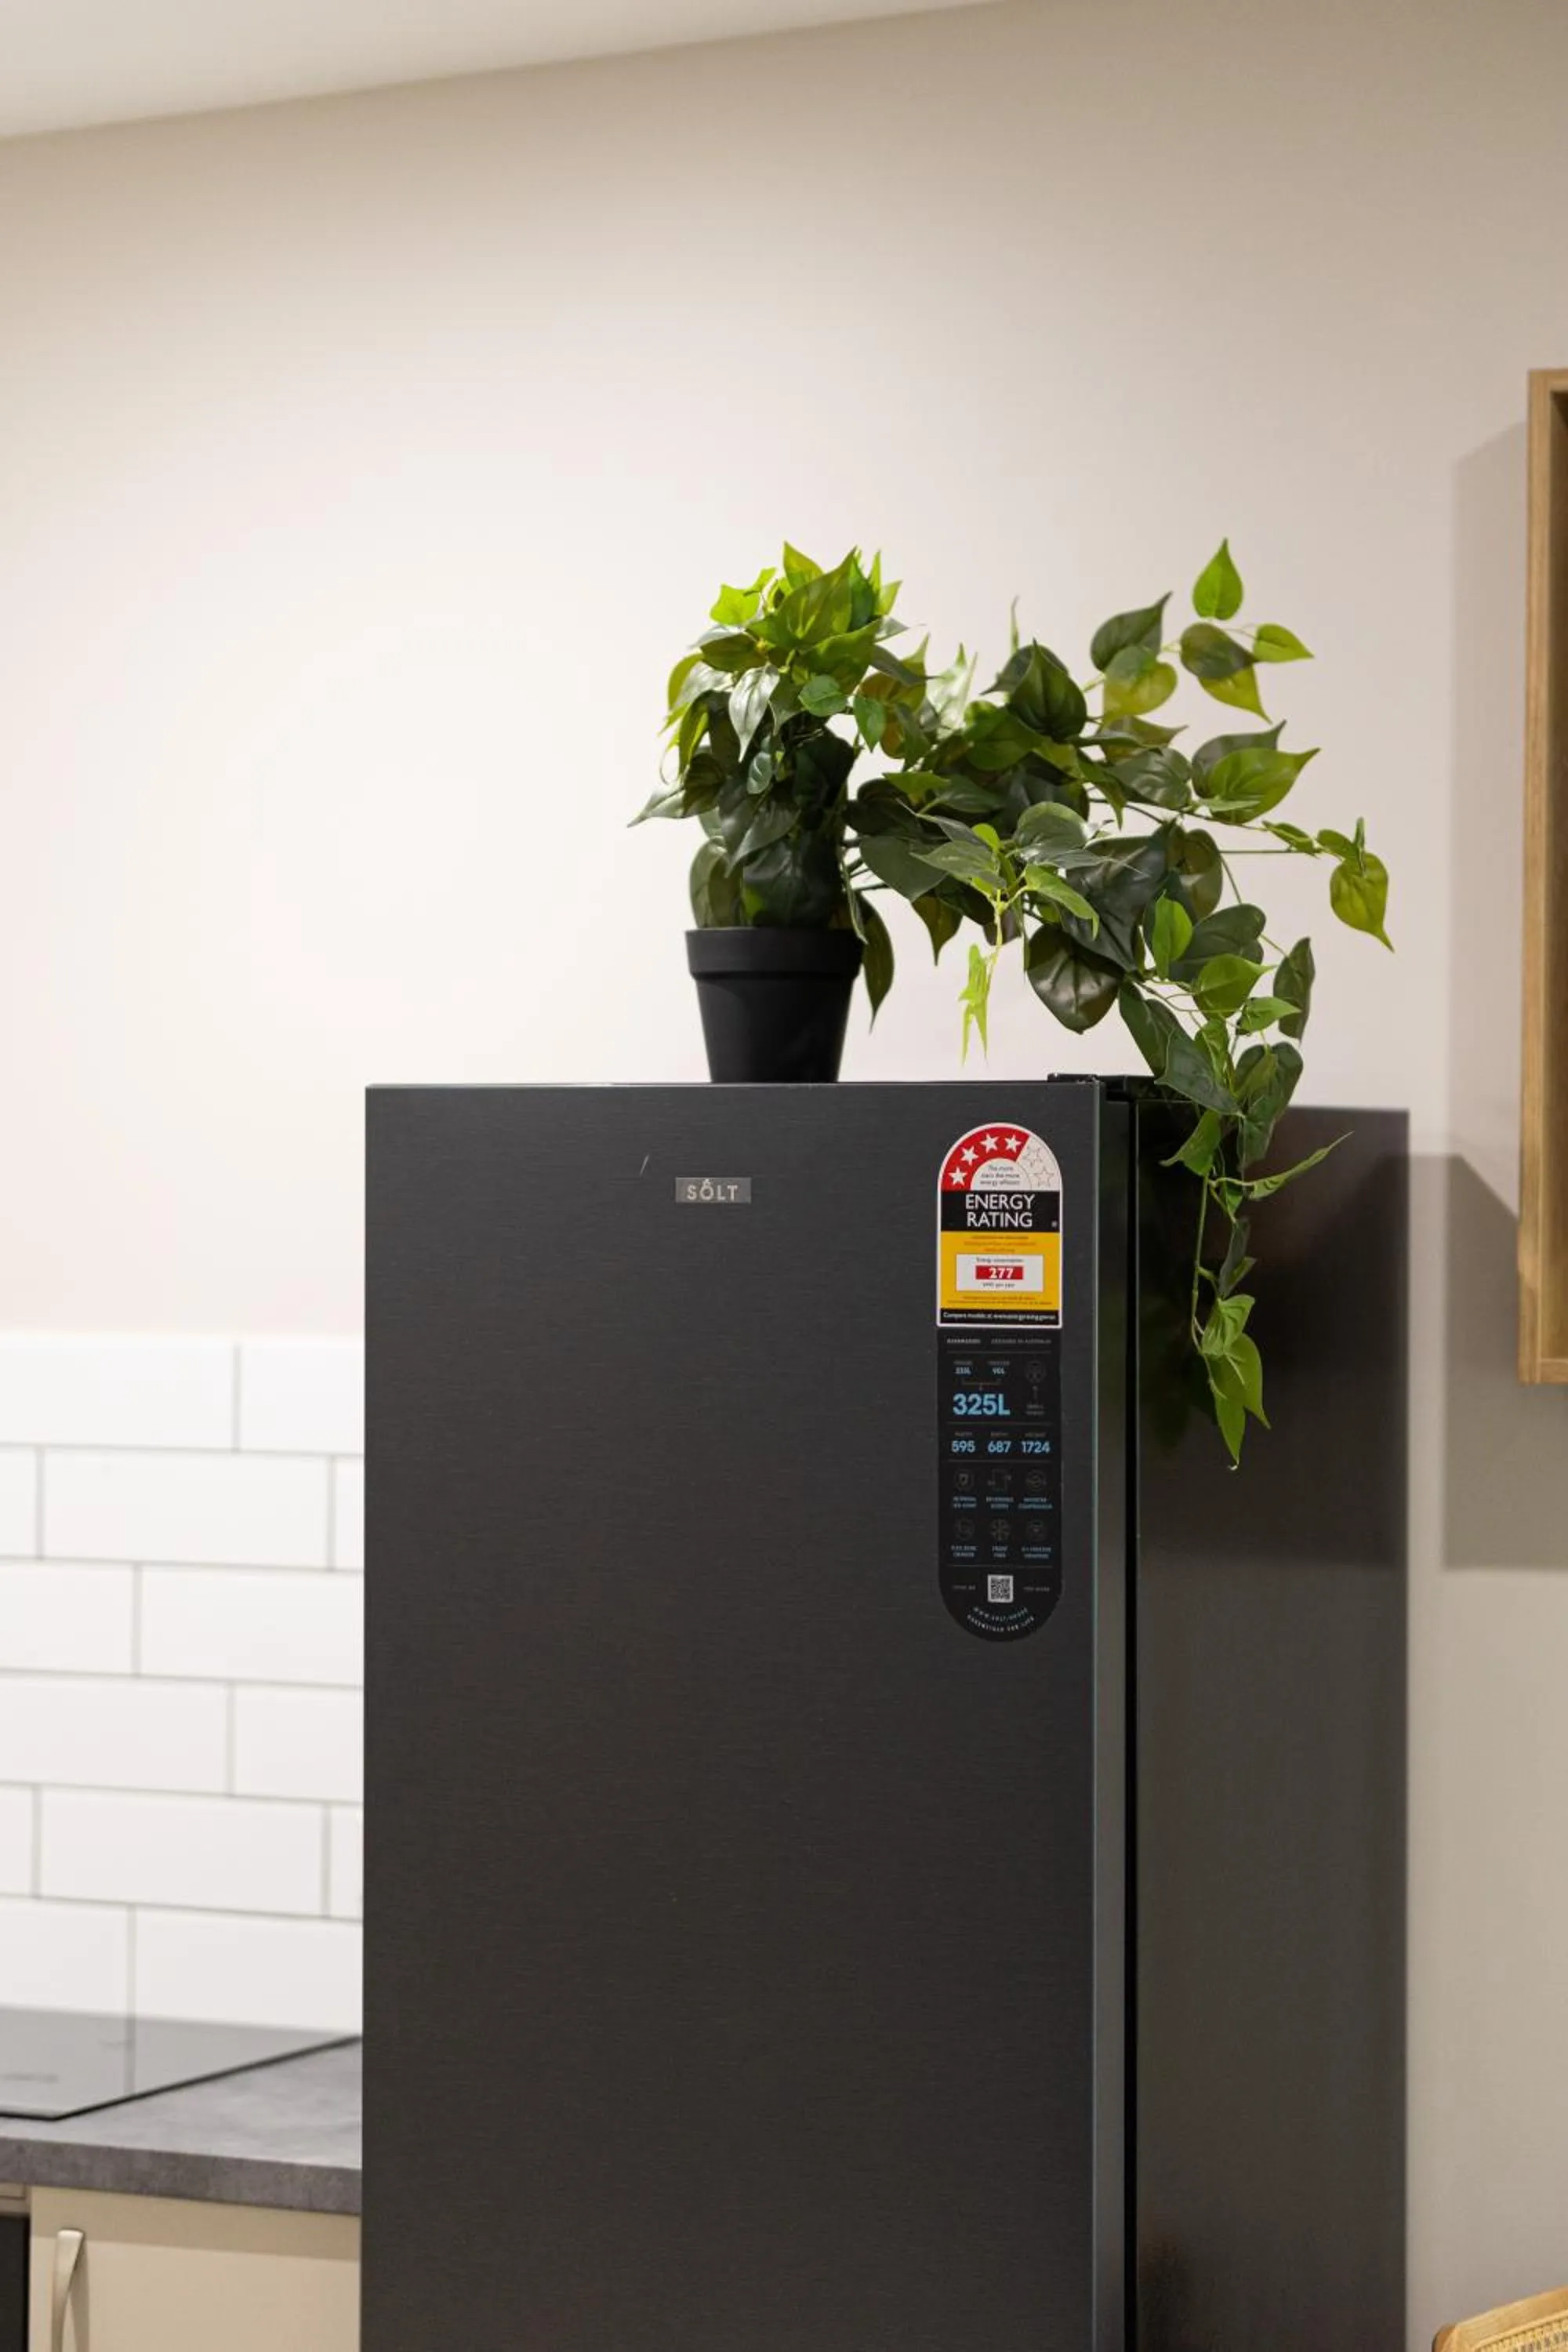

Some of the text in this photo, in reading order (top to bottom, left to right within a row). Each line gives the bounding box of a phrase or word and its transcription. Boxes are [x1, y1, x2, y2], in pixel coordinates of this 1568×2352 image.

[965, 1194, 1036, 1210] ENERGY
[967, 1212, 1033, 1228] RATING
[988, 1266, 1014, 1279] 277
[953, 1393, 1011, 1415] 325L
[951, 1440, 1051, 1454] 595 687 1724
